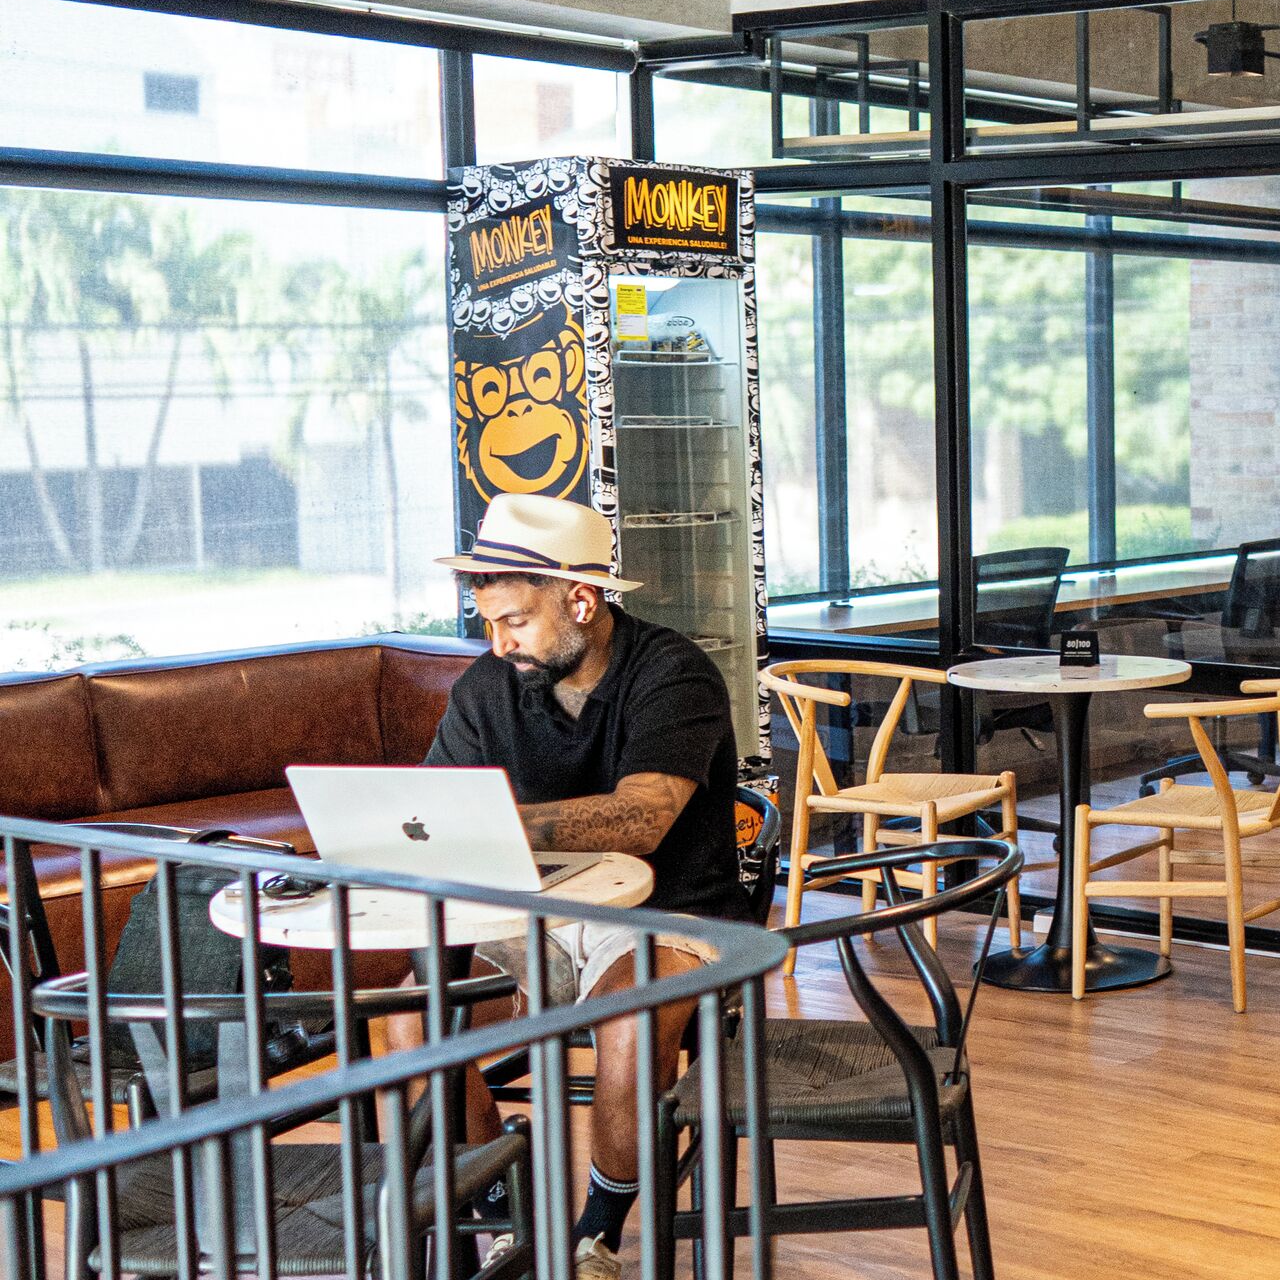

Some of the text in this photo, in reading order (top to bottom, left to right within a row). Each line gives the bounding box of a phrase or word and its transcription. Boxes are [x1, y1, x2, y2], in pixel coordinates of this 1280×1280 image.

[624, 176, 727, 236] MONKEY
[469, 204, 553, 279] MONKEY
[627, 235, 643, 245] UNA
[644, 237, 689, 247] EXPERIENCIA
[478, 282, 490, 292] UNA
[489, 270, 524, 288] EXPERIENCIA
